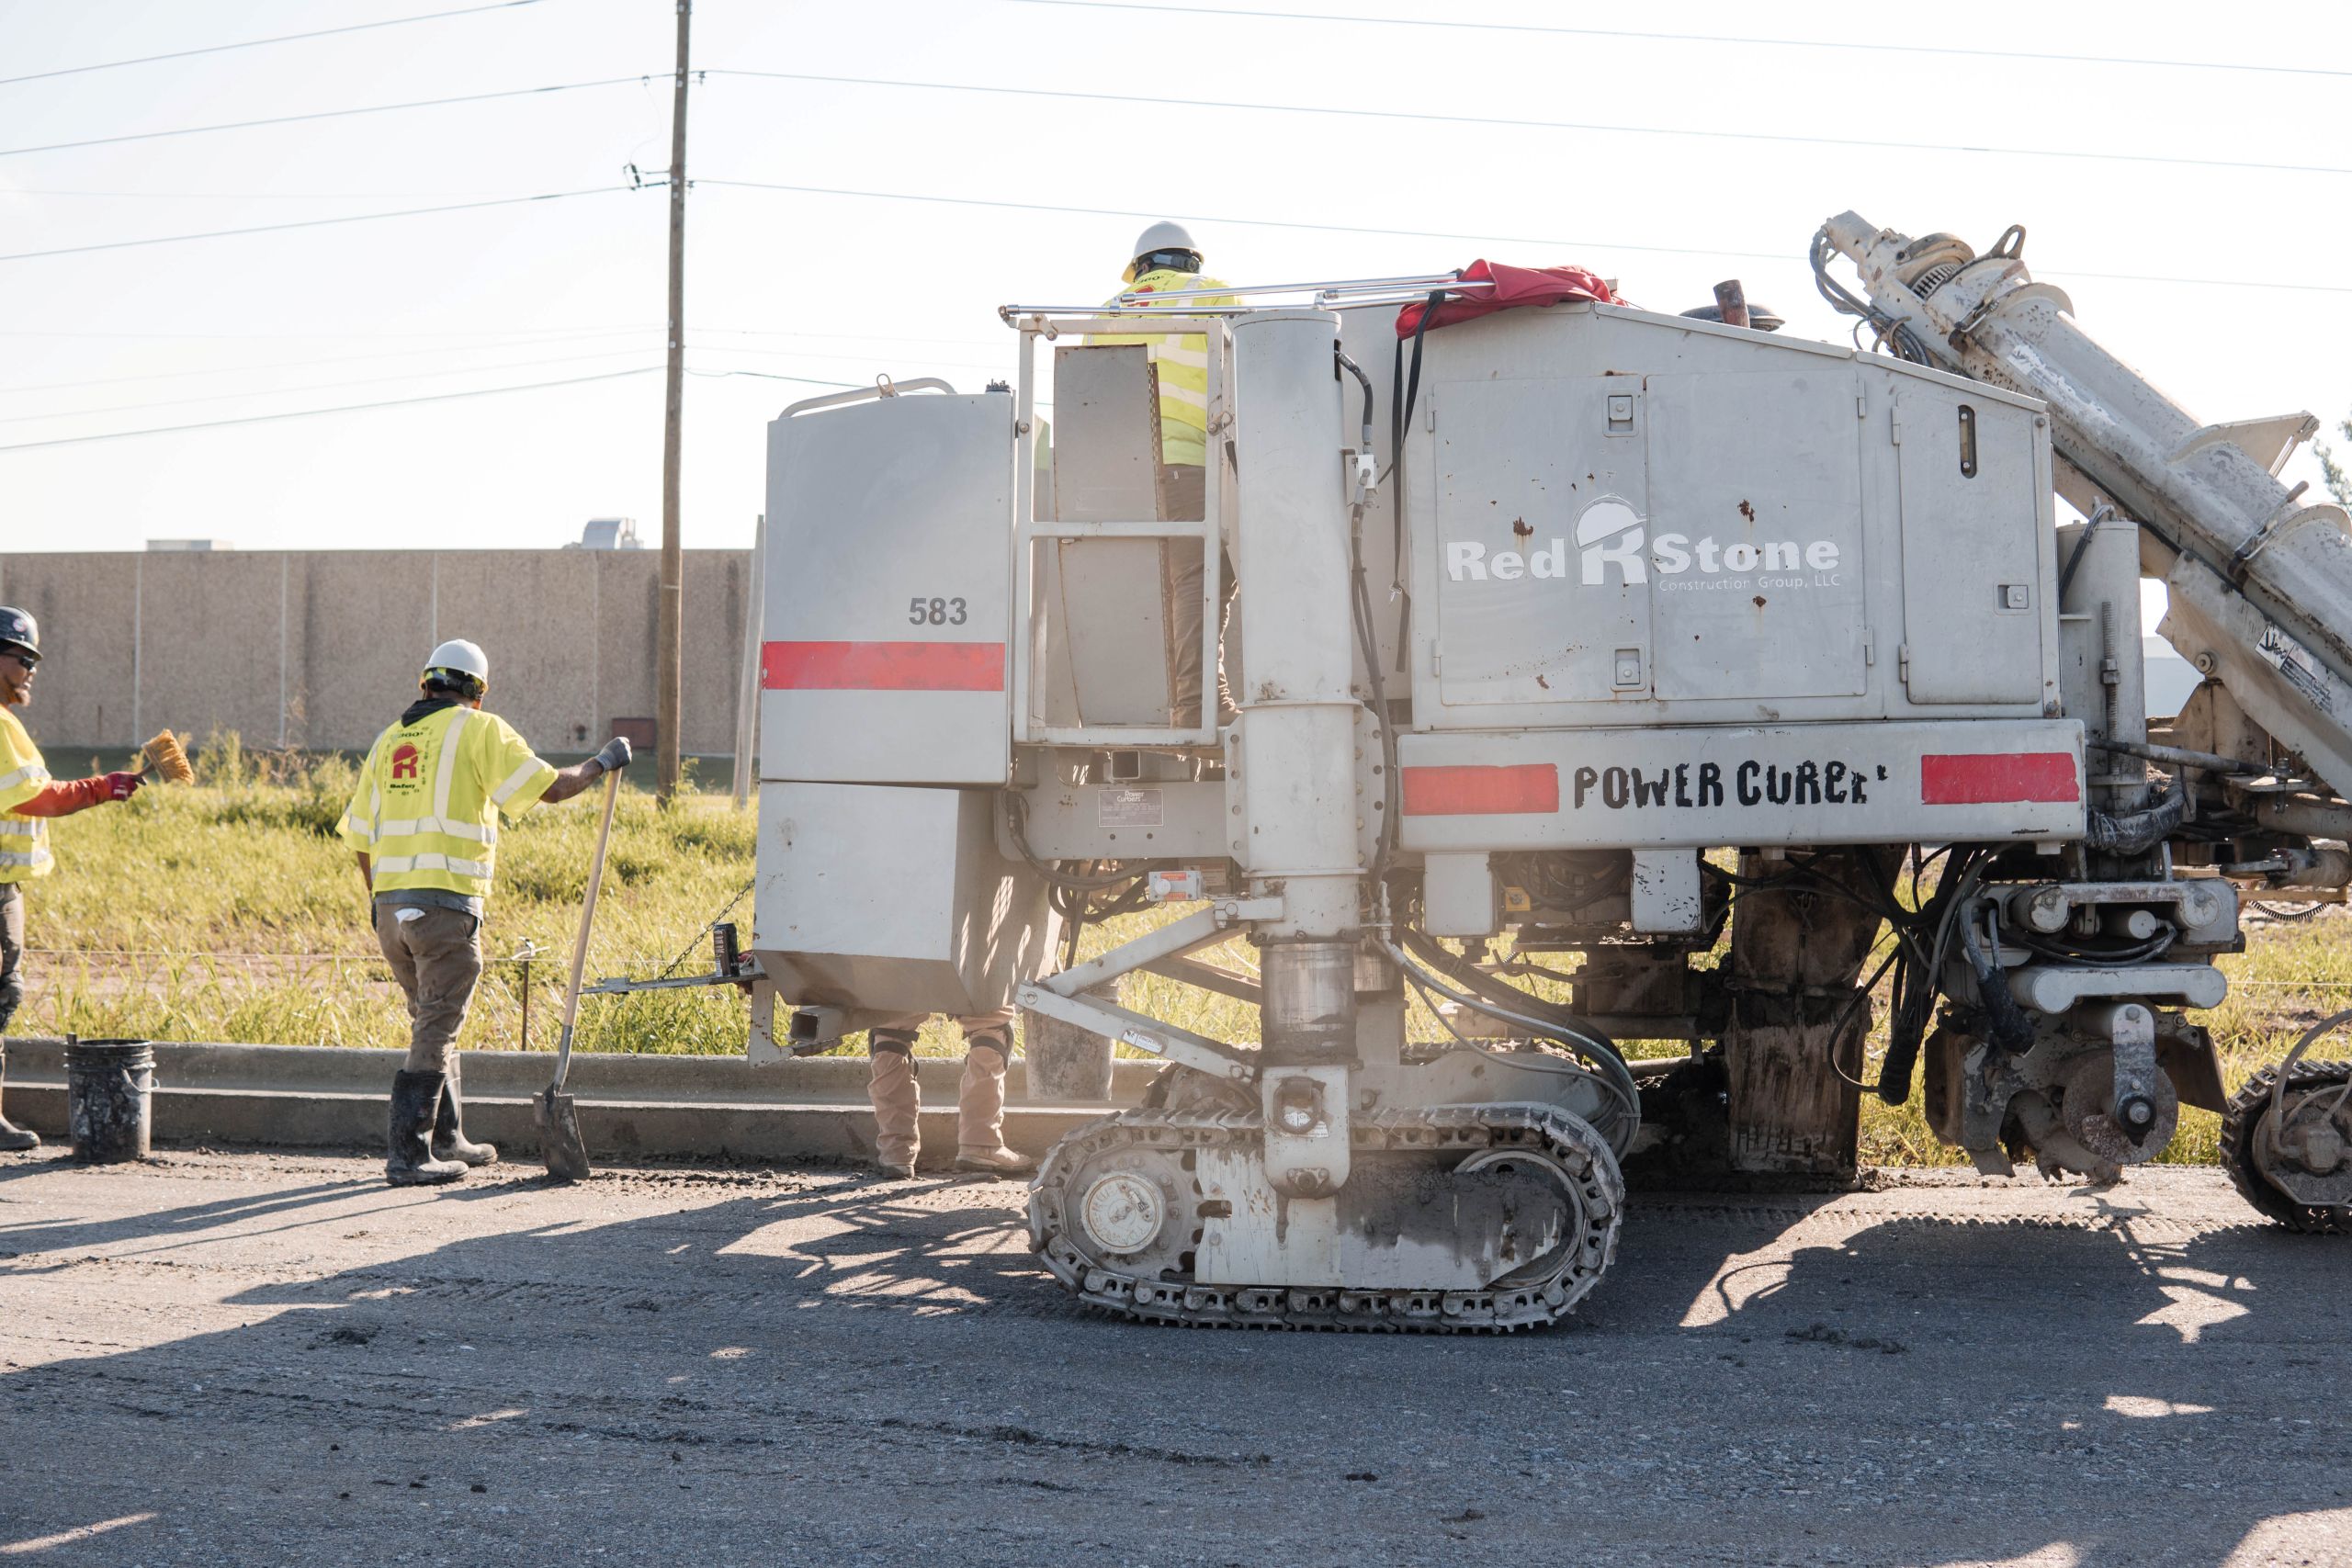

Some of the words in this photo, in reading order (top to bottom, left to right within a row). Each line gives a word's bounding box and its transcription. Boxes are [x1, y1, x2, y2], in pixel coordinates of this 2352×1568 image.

[1446, 537, 1566, 581] Red
[1652, 532, 1840, 574] Stone
[1659, 576, 1750, 592] Construction
[1758, 576, 1808, 590] Group,
[1815, 574, 1841, 588] LLC
[909, 597, 967, 626] 583
[1574, 761, 1724, 809] POWER
